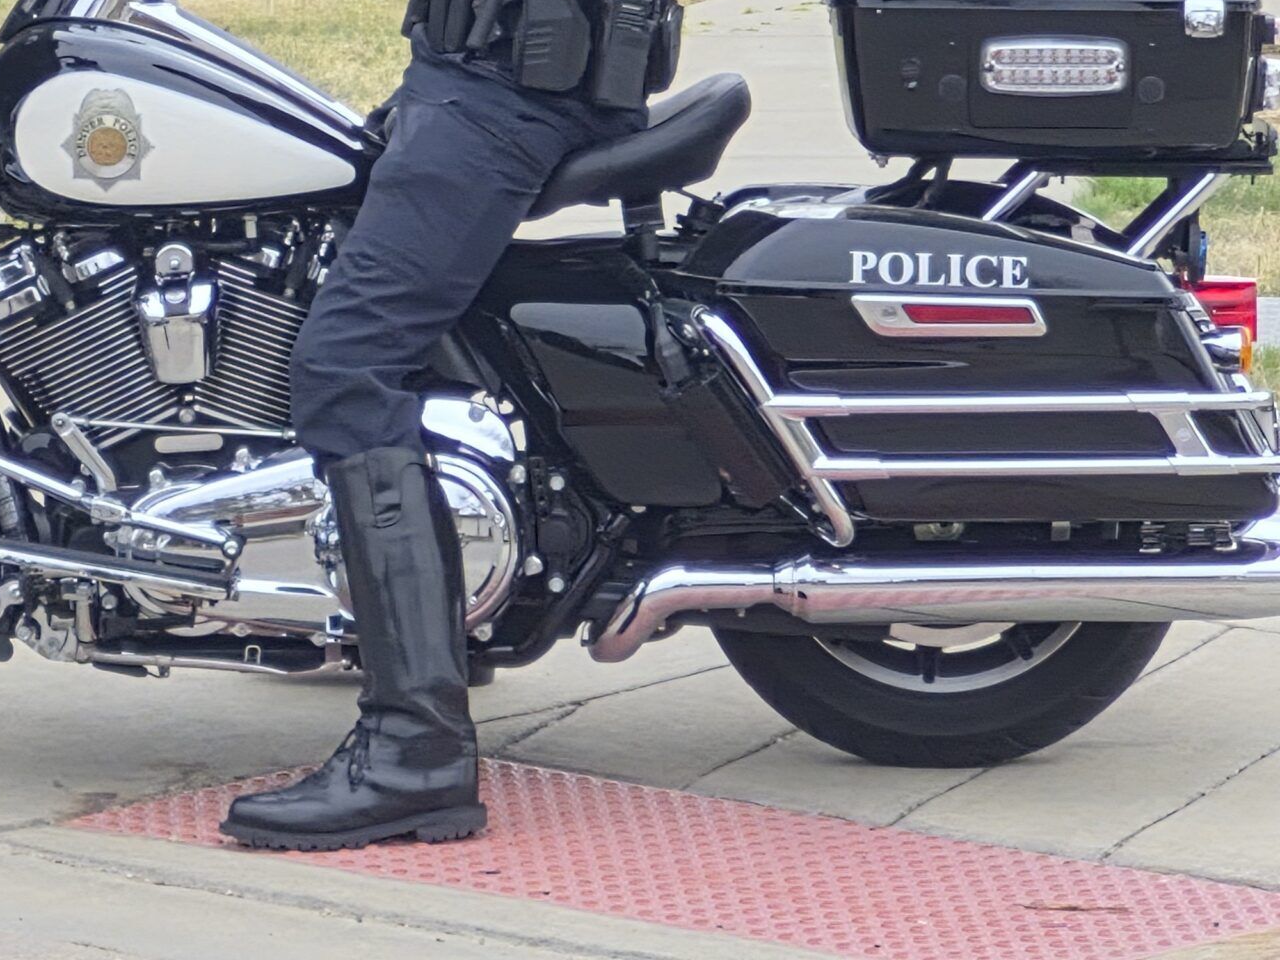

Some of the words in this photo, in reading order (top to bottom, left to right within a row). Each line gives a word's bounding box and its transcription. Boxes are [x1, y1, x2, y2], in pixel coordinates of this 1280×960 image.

[76, 116, 106, 159] DENVER
[112, 117, 137, 160] POLICE
[848, 250, 1030, 289] POLICE
